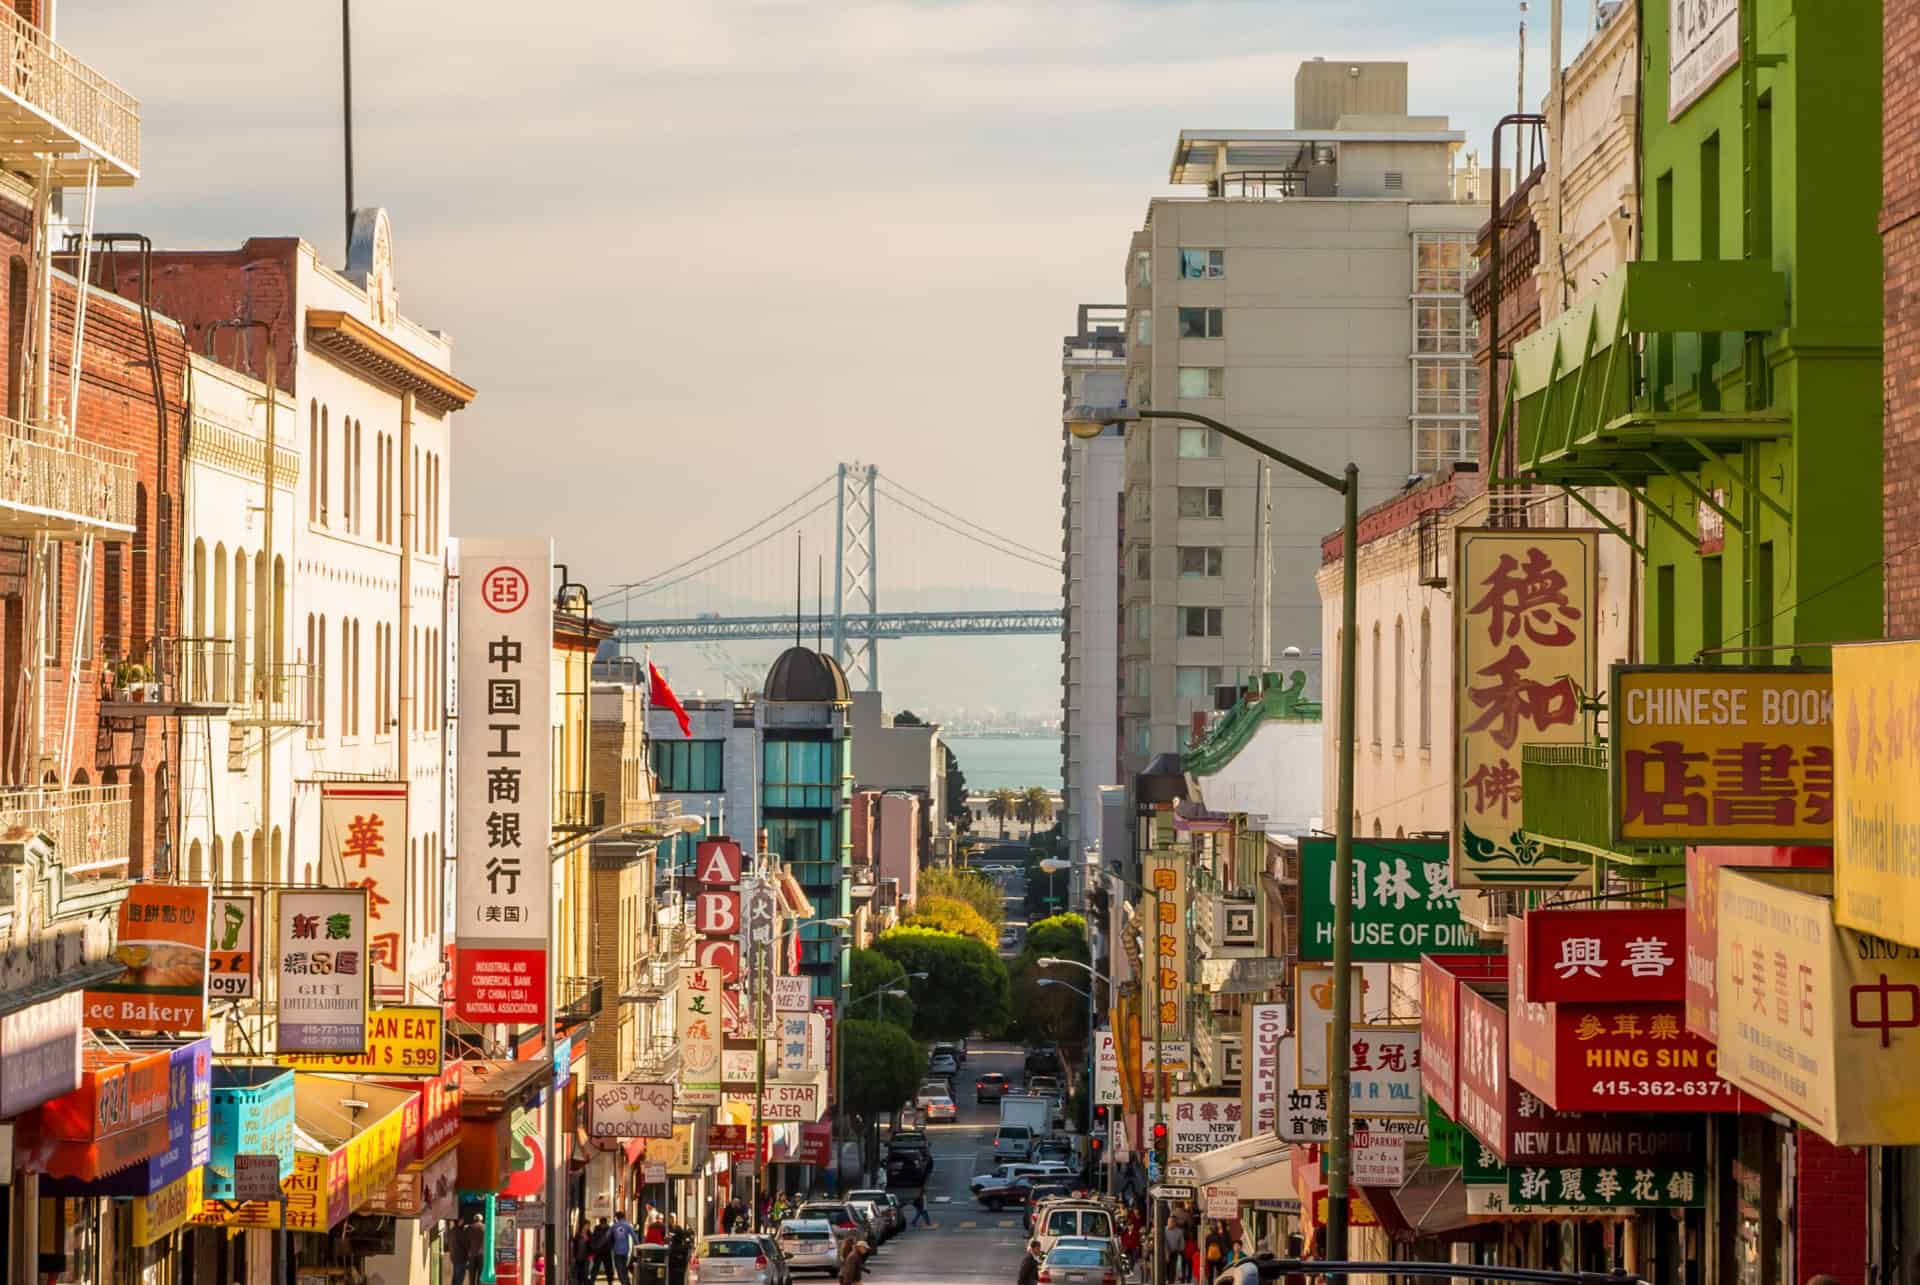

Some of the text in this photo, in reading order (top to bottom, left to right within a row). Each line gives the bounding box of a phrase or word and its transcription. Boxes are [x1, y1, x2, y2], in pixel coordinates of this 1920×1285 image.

[1627, 688, 1748, 726] CHINESE
[486, 635, 522, 895] 中国工商银行
[1316, 921, 1475, 947] HUSE OF DIM
[513, 961, 527, 973] AND
[1554, 936, 1675, 980] 興善
[472, 975, 532, 987] COMMERCIAL BANK
[477, 989, 486, 1000] OF
[488, 989, 507, 1000] CHINA
[121, 1001, 195, 1027] Bakery
[404, 1018, 436, 1040] EAT
[1574, 1013, 1681, 1041] 參茸藥
[402, 1048, 437, 1066] 5.99
[1586, 1049, 1649, 1068] HING
[1656, 1049, 1698, 1068] SIN
[780, 1087, 814, 1102] STAR
[1591, 1080, 1732, 1096] 415-362-6371
[595, 1085, 670, 1112] RED'S PLACE
[747, 1103, 801, 1118] TEATER
[595, 1121, 671, 1137] COCKTAILS
[1209, 1123, 1235, 1133] NEW
[1177, 1133, 1237, 1143] WOEY LOY
[1354, 1133, 1369, 1147] NO
[1514, 1131, 1550, 1154] NEW
[1556, 1131, 1583, 1154] LAI
[1587, 1131, 1622, 1154] WAH
